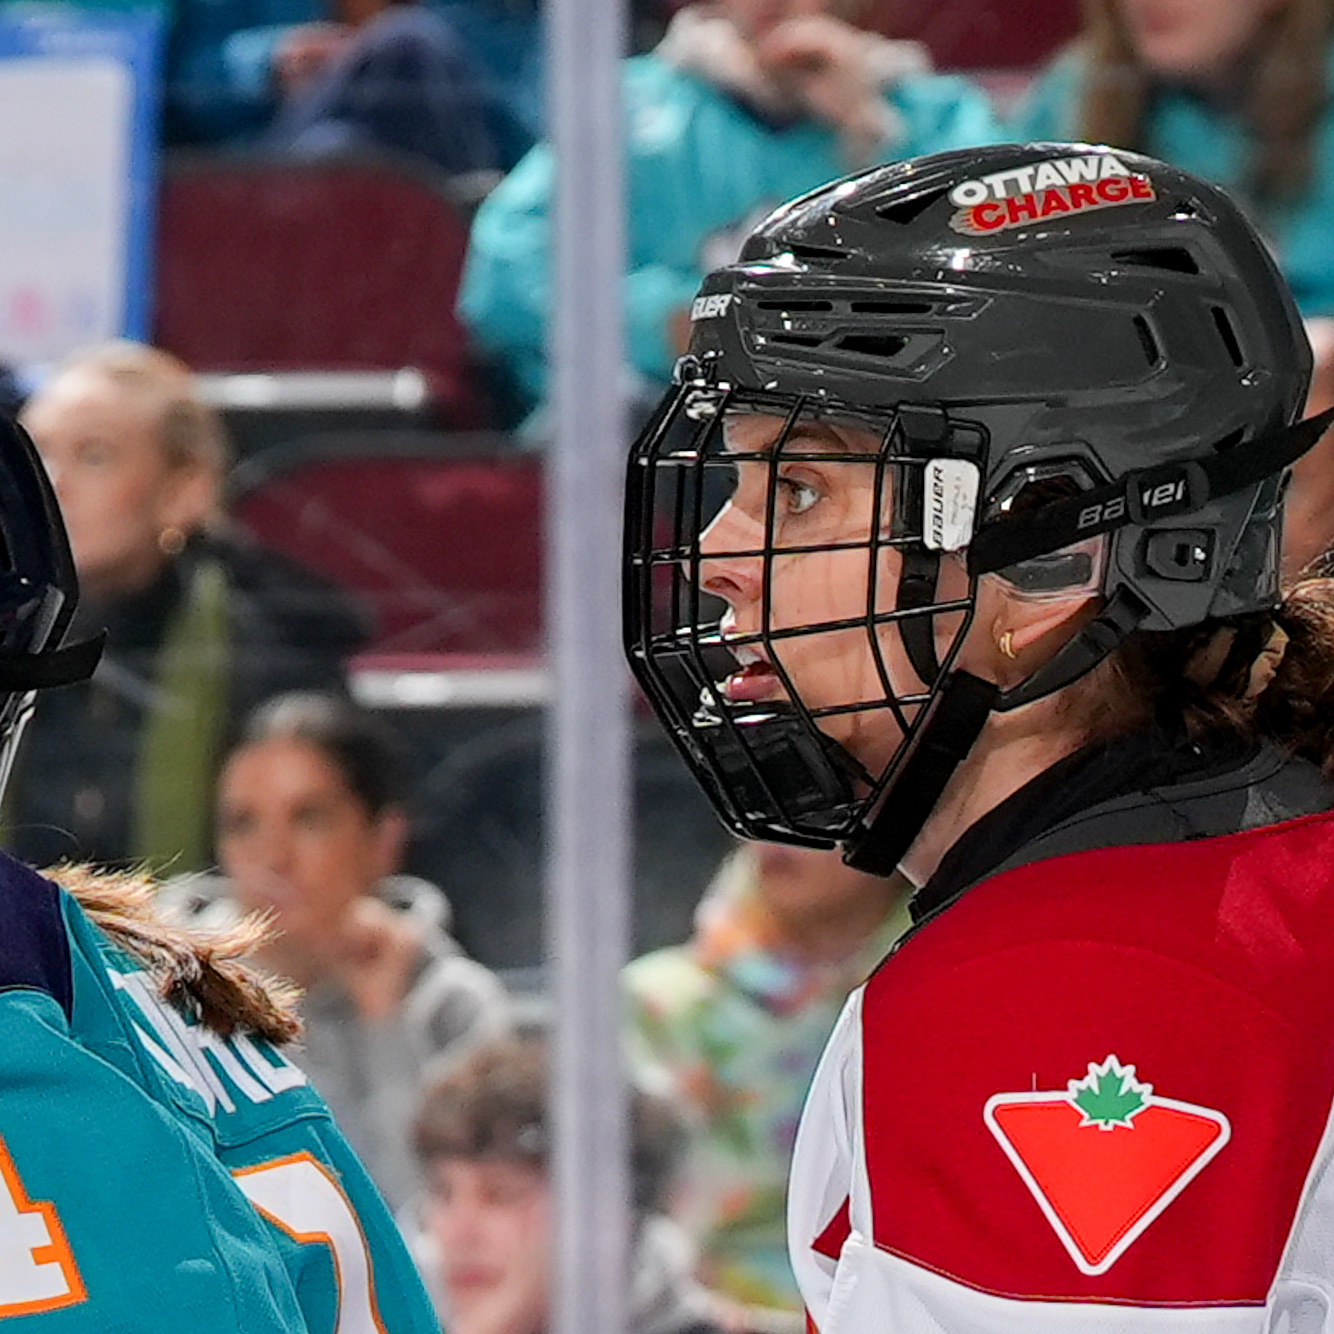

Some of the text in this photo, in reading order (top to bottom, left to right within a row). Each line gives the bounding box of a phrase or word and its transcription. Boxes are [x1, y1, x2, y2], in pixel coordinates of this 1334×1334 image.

[952, 155, 1131, 207] OTTAWA
[972, 176, 1153, 231] CHARGE
[932, 466, 944, 546] BAUER
